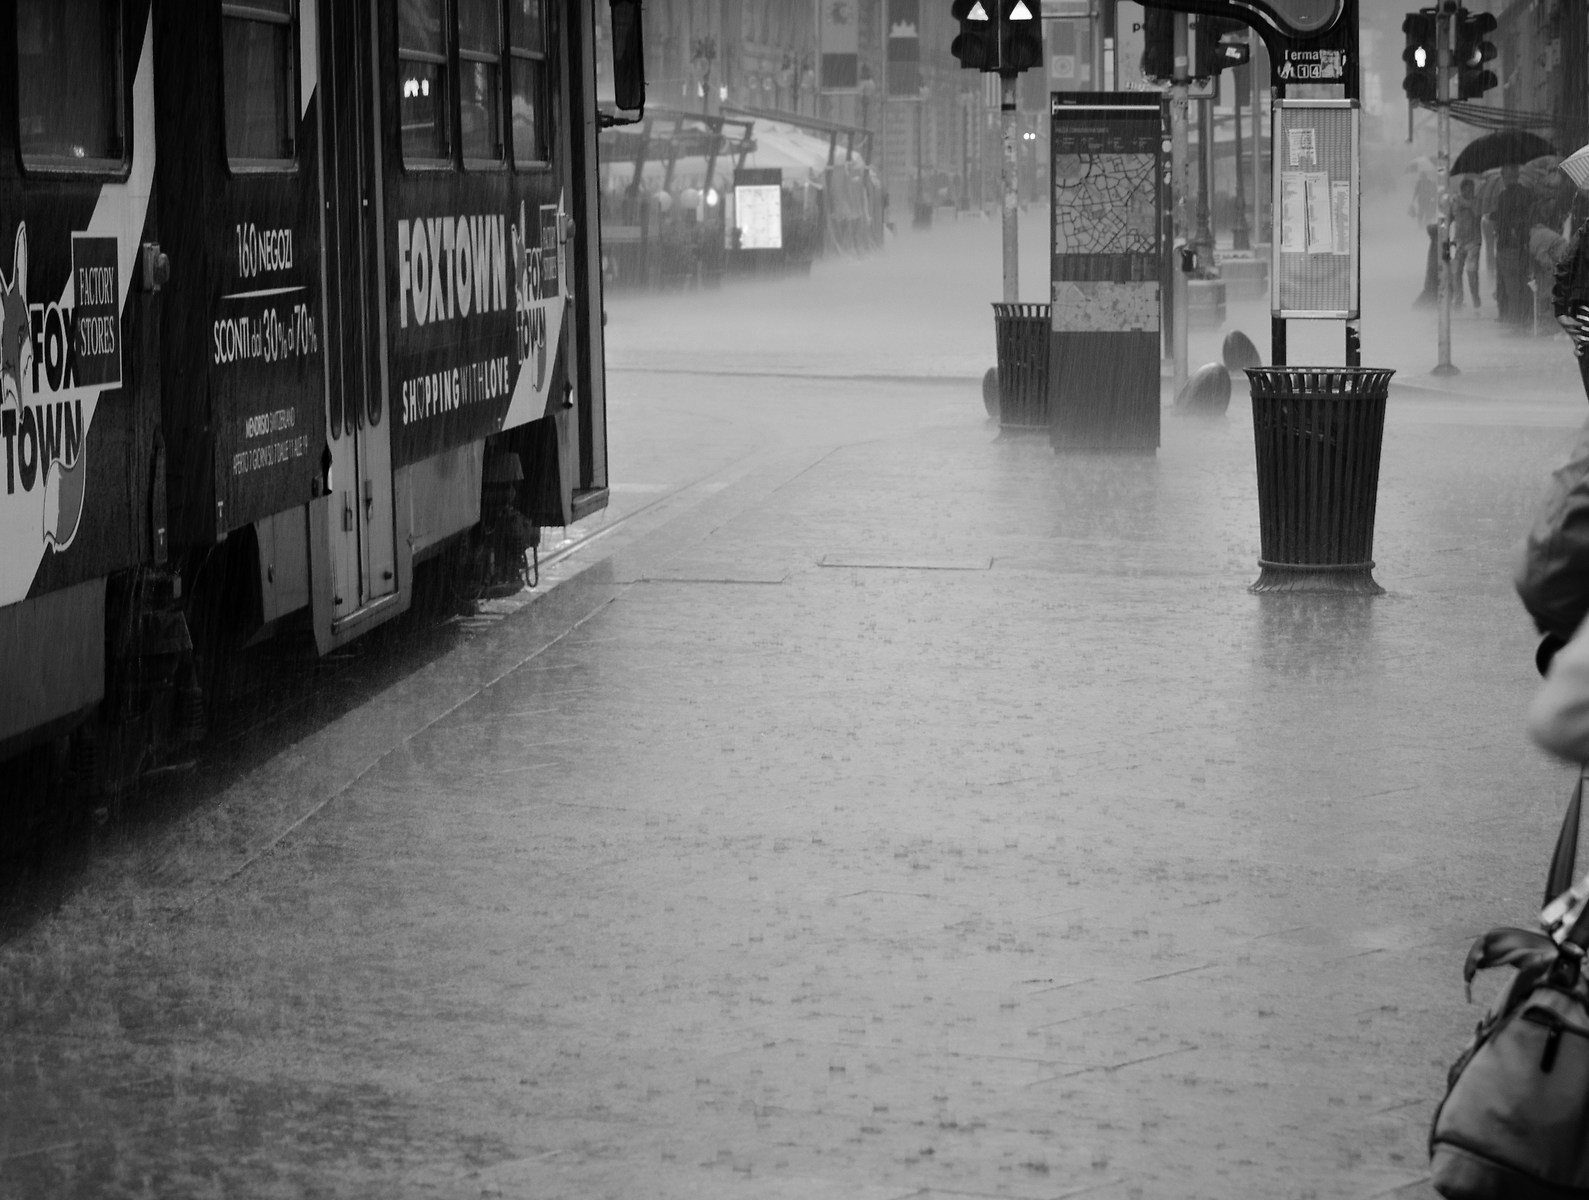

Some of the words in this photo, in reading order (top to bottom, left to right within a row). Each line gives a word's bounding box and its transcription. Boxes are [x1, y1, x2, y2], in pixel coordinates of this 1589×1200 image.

[236, 222, 257, 278] 160
[258, 228, 293, 272] NEGOZI
[398, 214, 507, 329] FOXTOWN
[79, 266, 115, 306] FACTORY
[29, 305, 80, 394] FOX
[80, 315, 115, 357] STORES
[214, 316, 250, 364] SCONTI
[263, 307, 288, 363] 30%
[294, 303, 318, 357] 70%
[2, 399, 83, 496] TOWN
